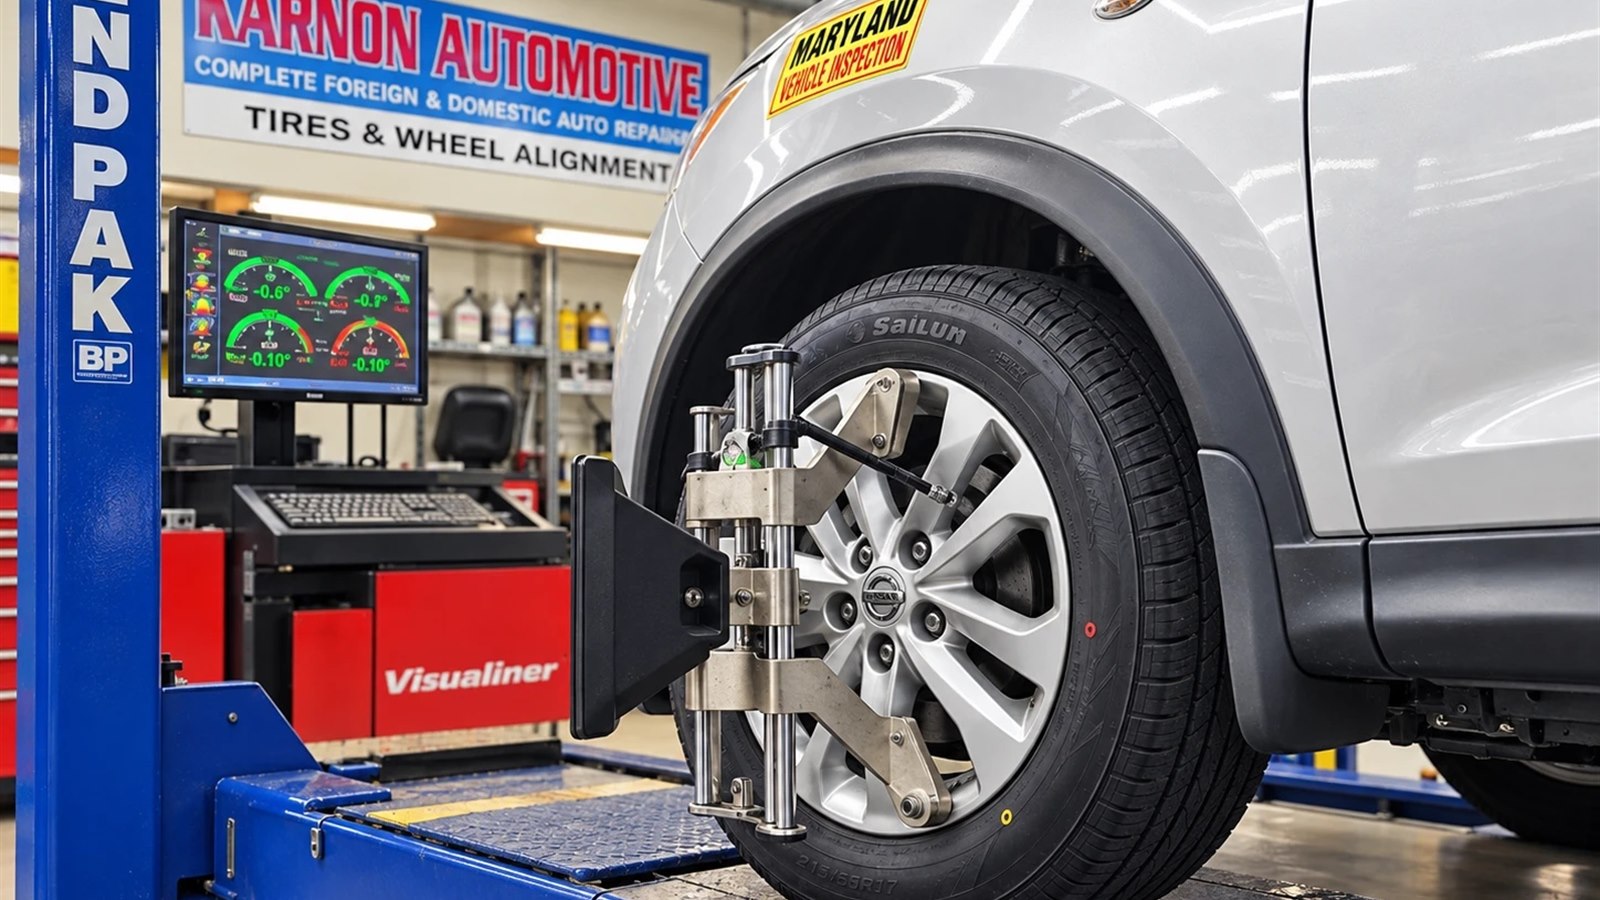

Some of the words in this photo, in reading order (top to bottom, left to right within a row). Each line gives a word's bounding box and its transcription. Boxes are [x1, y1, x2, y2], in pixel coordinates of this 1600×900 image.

[194, 0, 422, 75] KARNON
[431, 12, 703, 122] AUTOMOTIVE
[779, 58, 830, 104] VEHICLE
[827, 30, 909, 83] INSPECTION
[789, 0, 919, 70] MARYLAND
[194, 54, 318, 92] COMPLETE
[324, 74, 419, 108] FOREIGN
[425, 90, 442, 111] &
[448, 93, 552, 128] DOMESTIC
[556, 111, 609, 136] AUTO
[70, 0, 133, 334] NDPAK
[244, 105, 351, 142] TIRES
[362, 123, 386, 147] &
[395, 126, 505, 162] WHEEL
[514, 144, 672, 184] ALIGNMENT
[79, 344, 128, 372] BP
[385, 660, 560, 696] Visualiner
